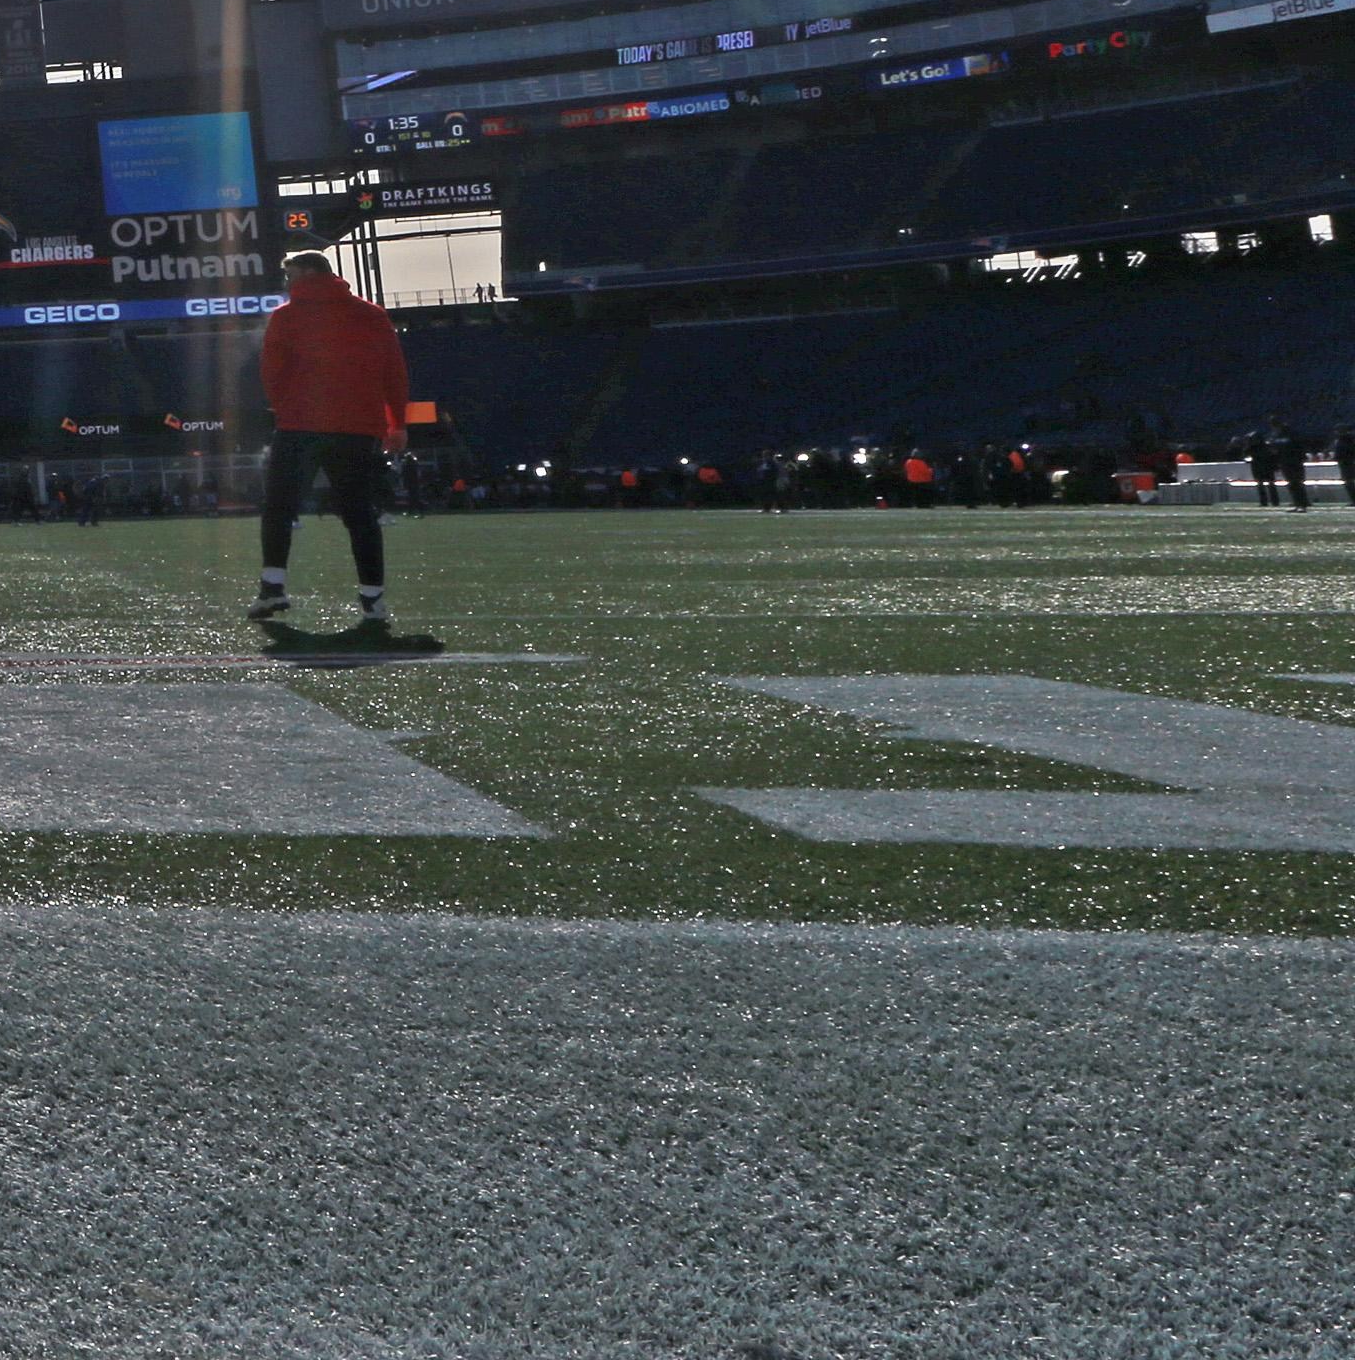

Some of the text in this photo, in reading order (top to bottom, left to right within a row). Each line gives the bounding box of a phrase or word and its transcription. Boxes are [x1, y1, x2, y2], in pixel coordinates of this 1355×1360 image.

[805, 18, 852, 39] jetBlue
[617, 43, 664, 65] TODAY'S
[1048, 37, 1108, 59] Party
[881, 64, 950, 85] Let's Go!
[660, 98, 731, 118] ABIOMED
[388, 116, 419, 131] 1:35
[452, 124, 463, 137] 0
[365, 131, 375, 145] 0
[382, 183, 491, 201] DRAFTKINGS
[287, 207, 309, 227] 25
[111, 211, 258, 248] OPTUM
[11, 245, 94, 263] CHARGERS
[112, 252, 264, 283] Putnam
[24, 303, 120, 324] GEICO
[186, 294, 285, 316] GEICO
[78, 424, 120, 436] OPTUM
[182, 420, 224, 432] OPTUM
